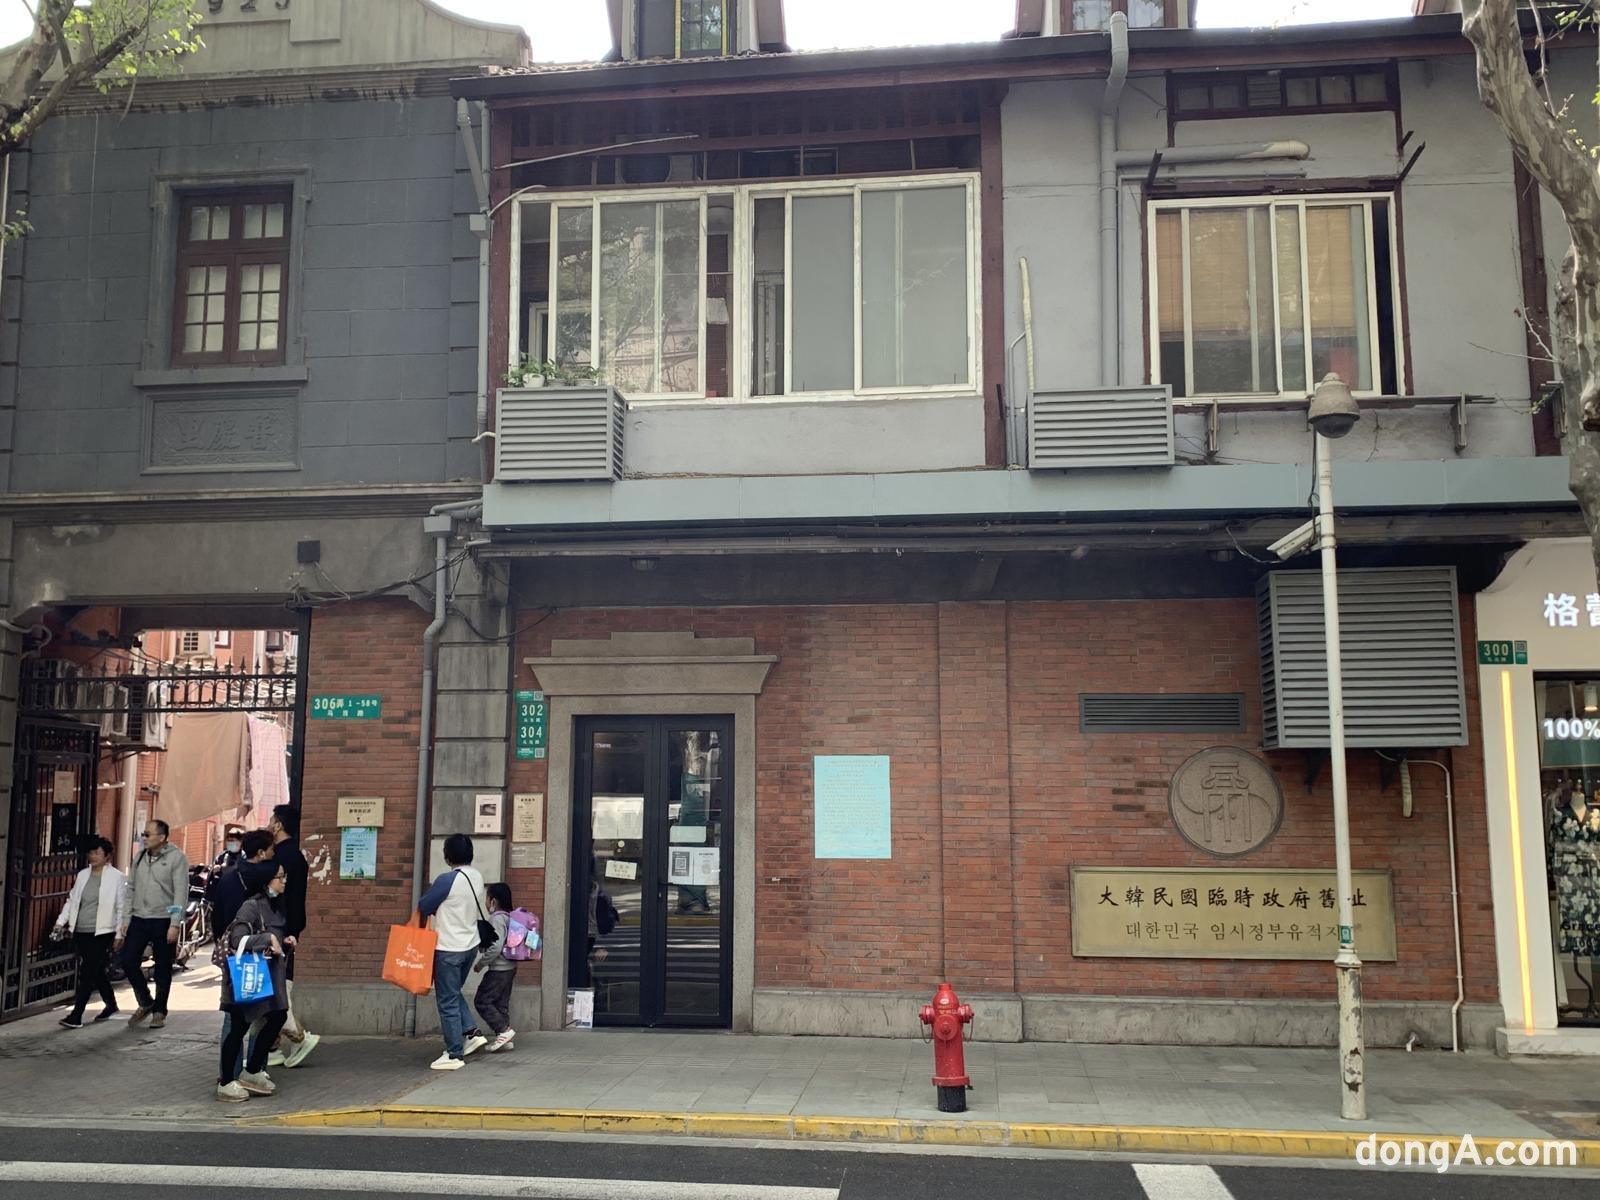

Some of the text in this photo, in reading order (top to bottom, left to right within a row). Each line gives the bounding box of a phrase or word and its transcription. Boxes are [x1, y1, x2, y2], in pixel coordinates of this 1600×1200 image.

[1483, 643, 1509, 657] 300
[521, 704, 544, 717] 302
[520, 726, 543, 739] 304
[1543, 718, 1600, 739] 100%
[1098, 885, 1368, 910] 大韓民國臨時政府舊址
[1125, 921, 1341, 942] 대한민국 임시정부유적지
